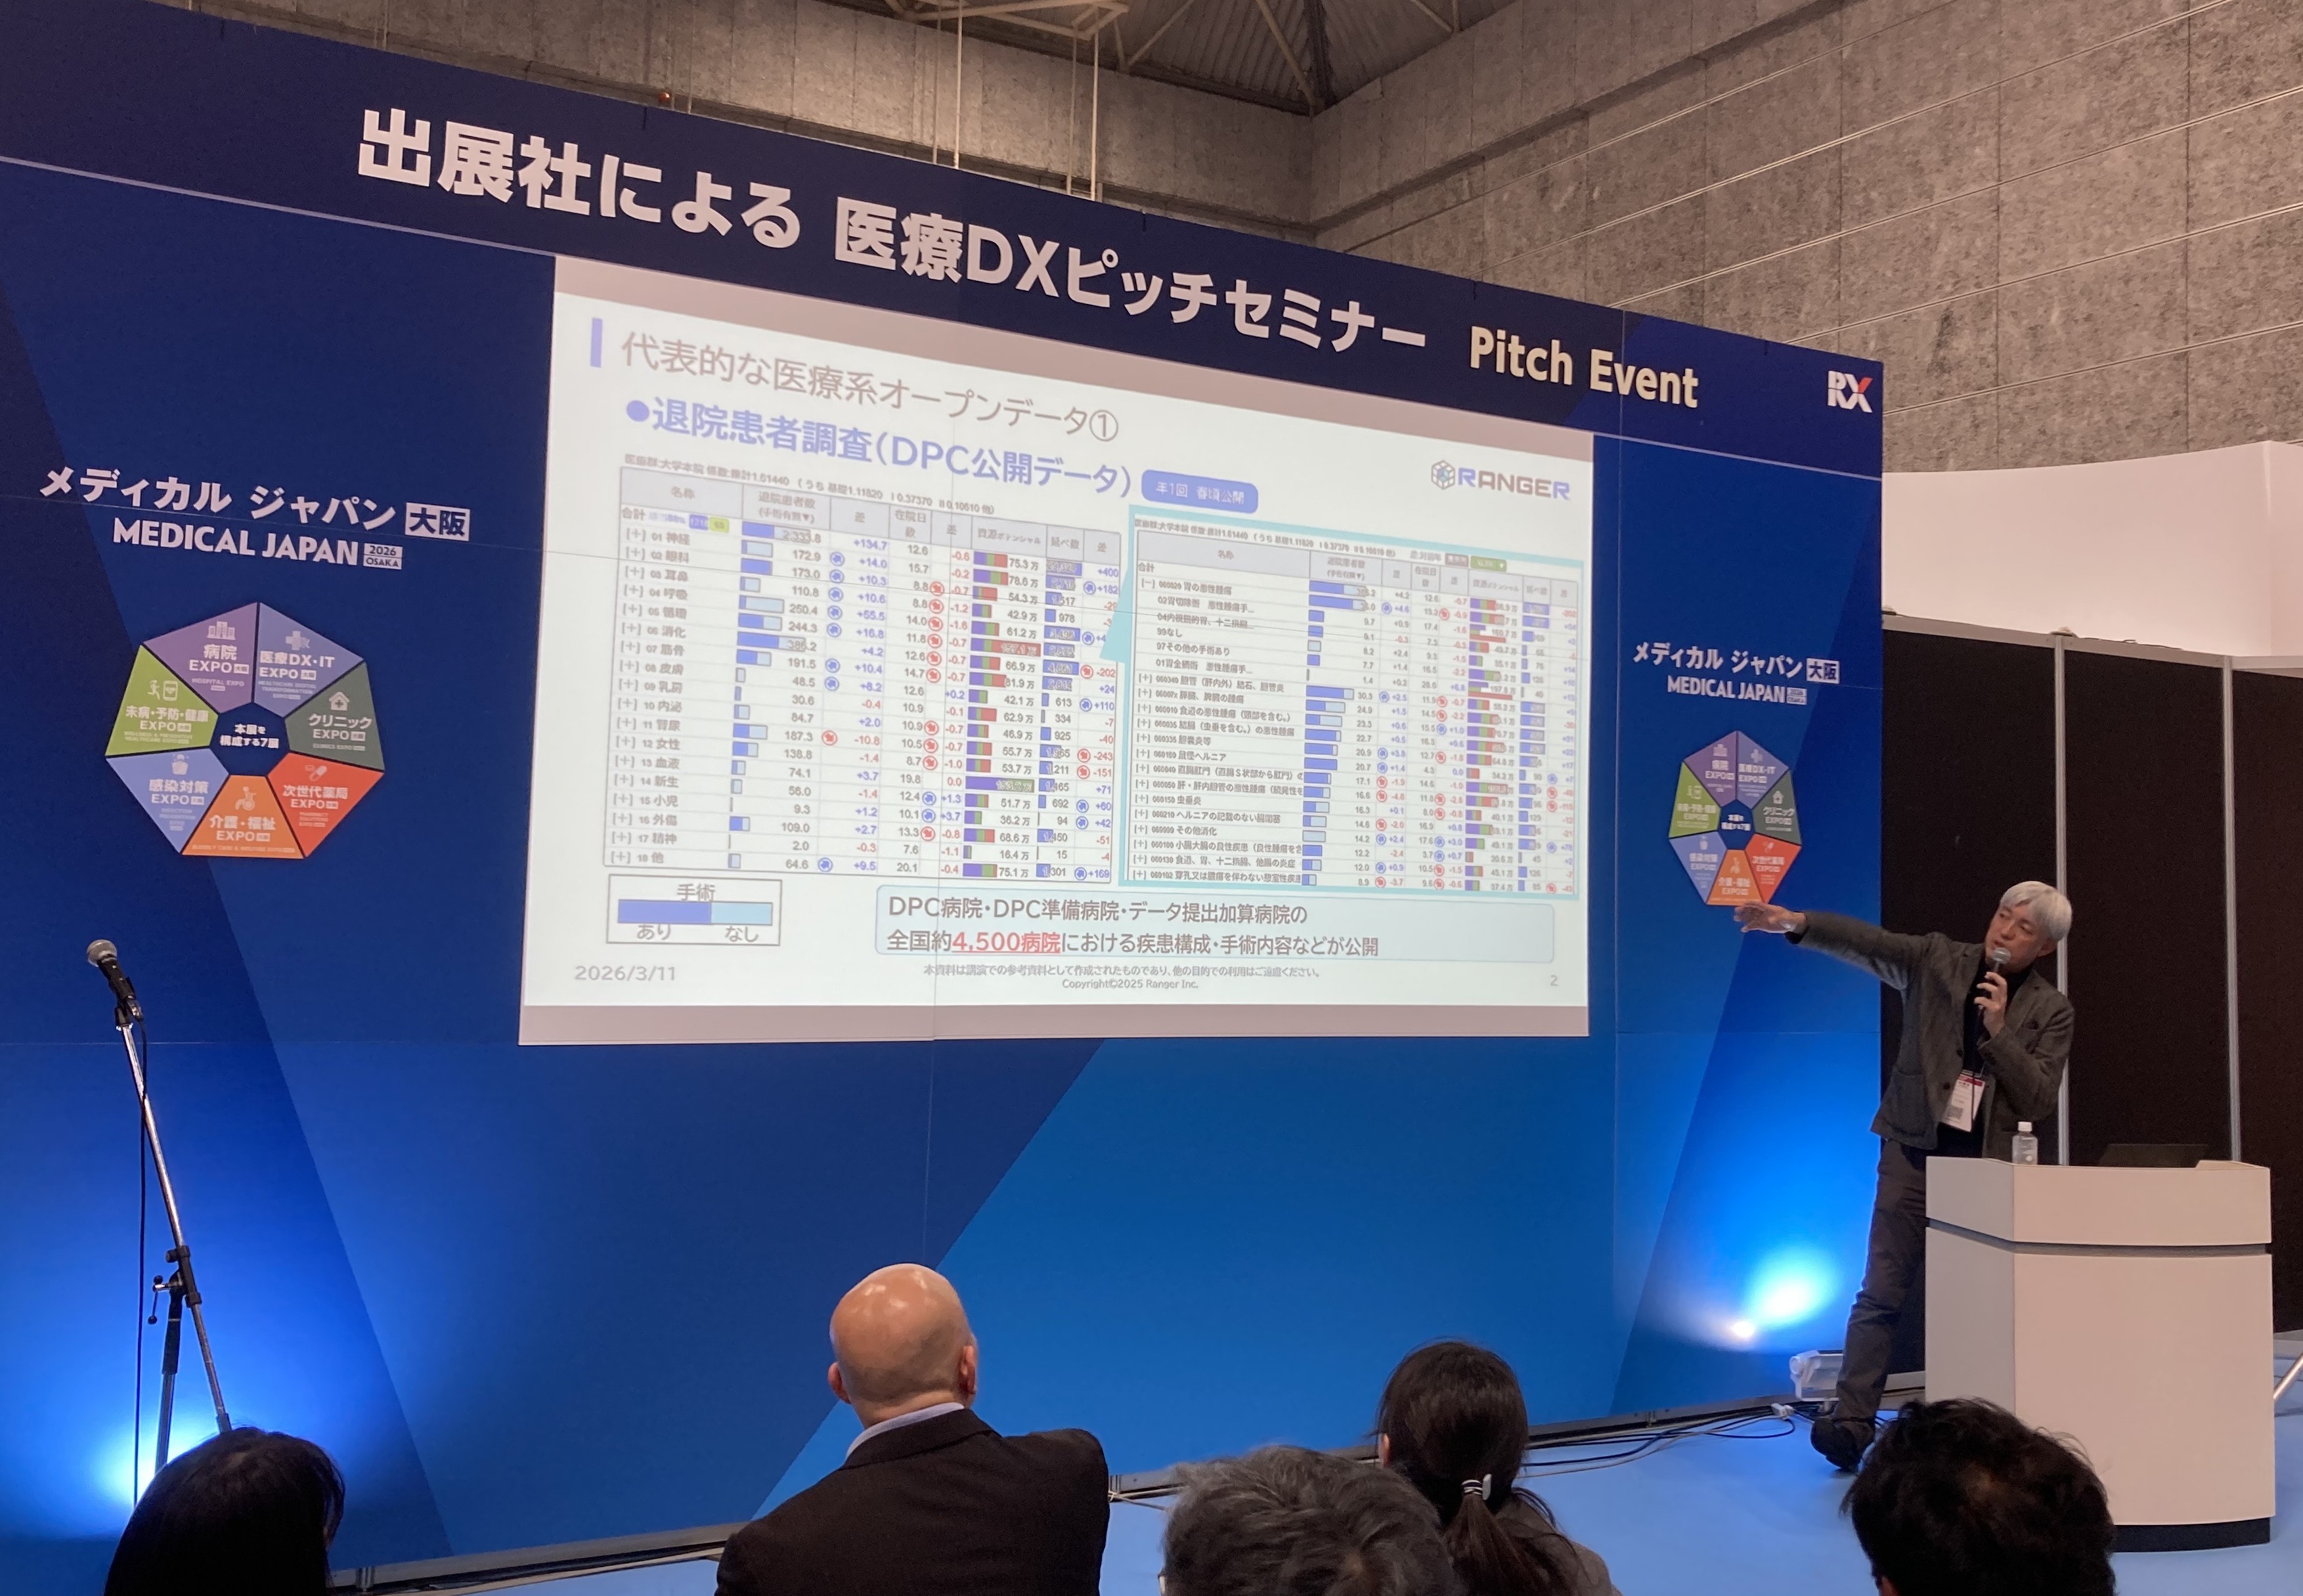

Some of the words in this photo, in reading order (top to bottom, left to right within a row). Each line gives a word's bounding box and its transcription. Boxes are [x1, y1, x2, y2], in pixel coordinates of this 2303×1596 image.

[358, 107, 801, 249] 出展社による
[835, 196, 1426, 353] 医療DXピッチセミナー
[1470, 325, 1574, 386] Pitch
[1589, 348, 1700, 410] Event
[622, 332, 1119, 442] 代表的な医療系オープンデータ①
[1827, 370, 1873, 414] RX
[1457, 467, 1571, 501] RANGER
[39, 466, 232, 515] メディカル
[248, 485, 397, 531] ジャパン
[409, 507, 466, 537] 大阪
[112, 517, 256, 557] MEDICAL
[262, 532, 359, 566] JAPAN
[369, 545, 397, 556] 2026
[908, 544, 929, 556] 12.6
[366, 557, 399, 567] OSAKA
[793, 550, 821, 563] 172.9
[909, 563, 929, 574] 15.7
[792, 567, 821, 580] 173.0
[913, 580, 929, 592] 8.8
[792, 585, 820, 597] 110.8
[913, 597, 928, 609] 8.8
[790, 603, 818, 615] 250.4
[906, 615, 927, 626] 14.0
[789, 621, 818, 634] 244.3
[906, 633, 927, 644] 11.8
[204, 644, 238, 660] 病院
[661, 625, 686, 638] 消化
[905, 650, 925, 662] 12.6
[189, 659, 232, 674] EXPO
[788, 658, 816, 670] 191.5
[904, 668, 925, 679] 14.7
[1633, 641, 1724, 671] メディカル
[1730, 649, 1803, 679] ジャパン
[1808, 661, 1838, 681] 大阪
[259, 667, 299, 679] EXPO
[793, 676, 816, 688] 48.5
[904, 685, 924, 697] 12.6
[1667, 674, 1736, 700] MEDICAL
[1738, 682, 1786, 704] JAPAN
[792, 694, 815, 706] 30.6
[903, 702, 924, 714] 10.9
[140, 720, 176, 732] EXPO
[309, 713, 372, 729] クリニック
[791, 712, 814, 723] 84.7
[902, 720, 923, 731] 10.9
[313, 729, 349, 741] EXPO
[785, 730, 814, 742] 187.3
[902, 739, 923, 750] 10.5
[656, 738, 680, 750] 女性
[784, 748, 813, 760] 138.8
[906, 756, 922, 767] 8.7
[789, 767, 811, 778] 74.1
[900, 773, 921, 785] 19.8
[148, 779, 209, 794] 感染対策
[151, 793, 190, 806] EXPO
[290, 798, 325, 809] EXPO
[900, 791, 921, 802] 12.4
[653, 794, 678, 808] 小児
[794, 804, 810, 815] 9.3
[899, 809, 919, 819] 10.1
[215, 830, 255, 842] EXPO
[781, 822, 810, 833] 109.0
[898, 827, 919, 838] 13.3
[793, 840, 810, 852] 2.0
[904, 844, 919, 855] 7.6
[651, 852, 665, 864] 他
[785, 859, 809, 870] 64.6
[896, 862, 918, 873] 20.1
[676, 883, 716, 902] 手術
[636, 924, 672, 941] あり
[724, 926, 759, 943] なし
[573, 965, 676, 981] 2026/3/11
[1550, 974, 1559, 987] 2
[1146, 979, 1179, 989] Ranger
[1182, 979, 1199, 989] Inc.
